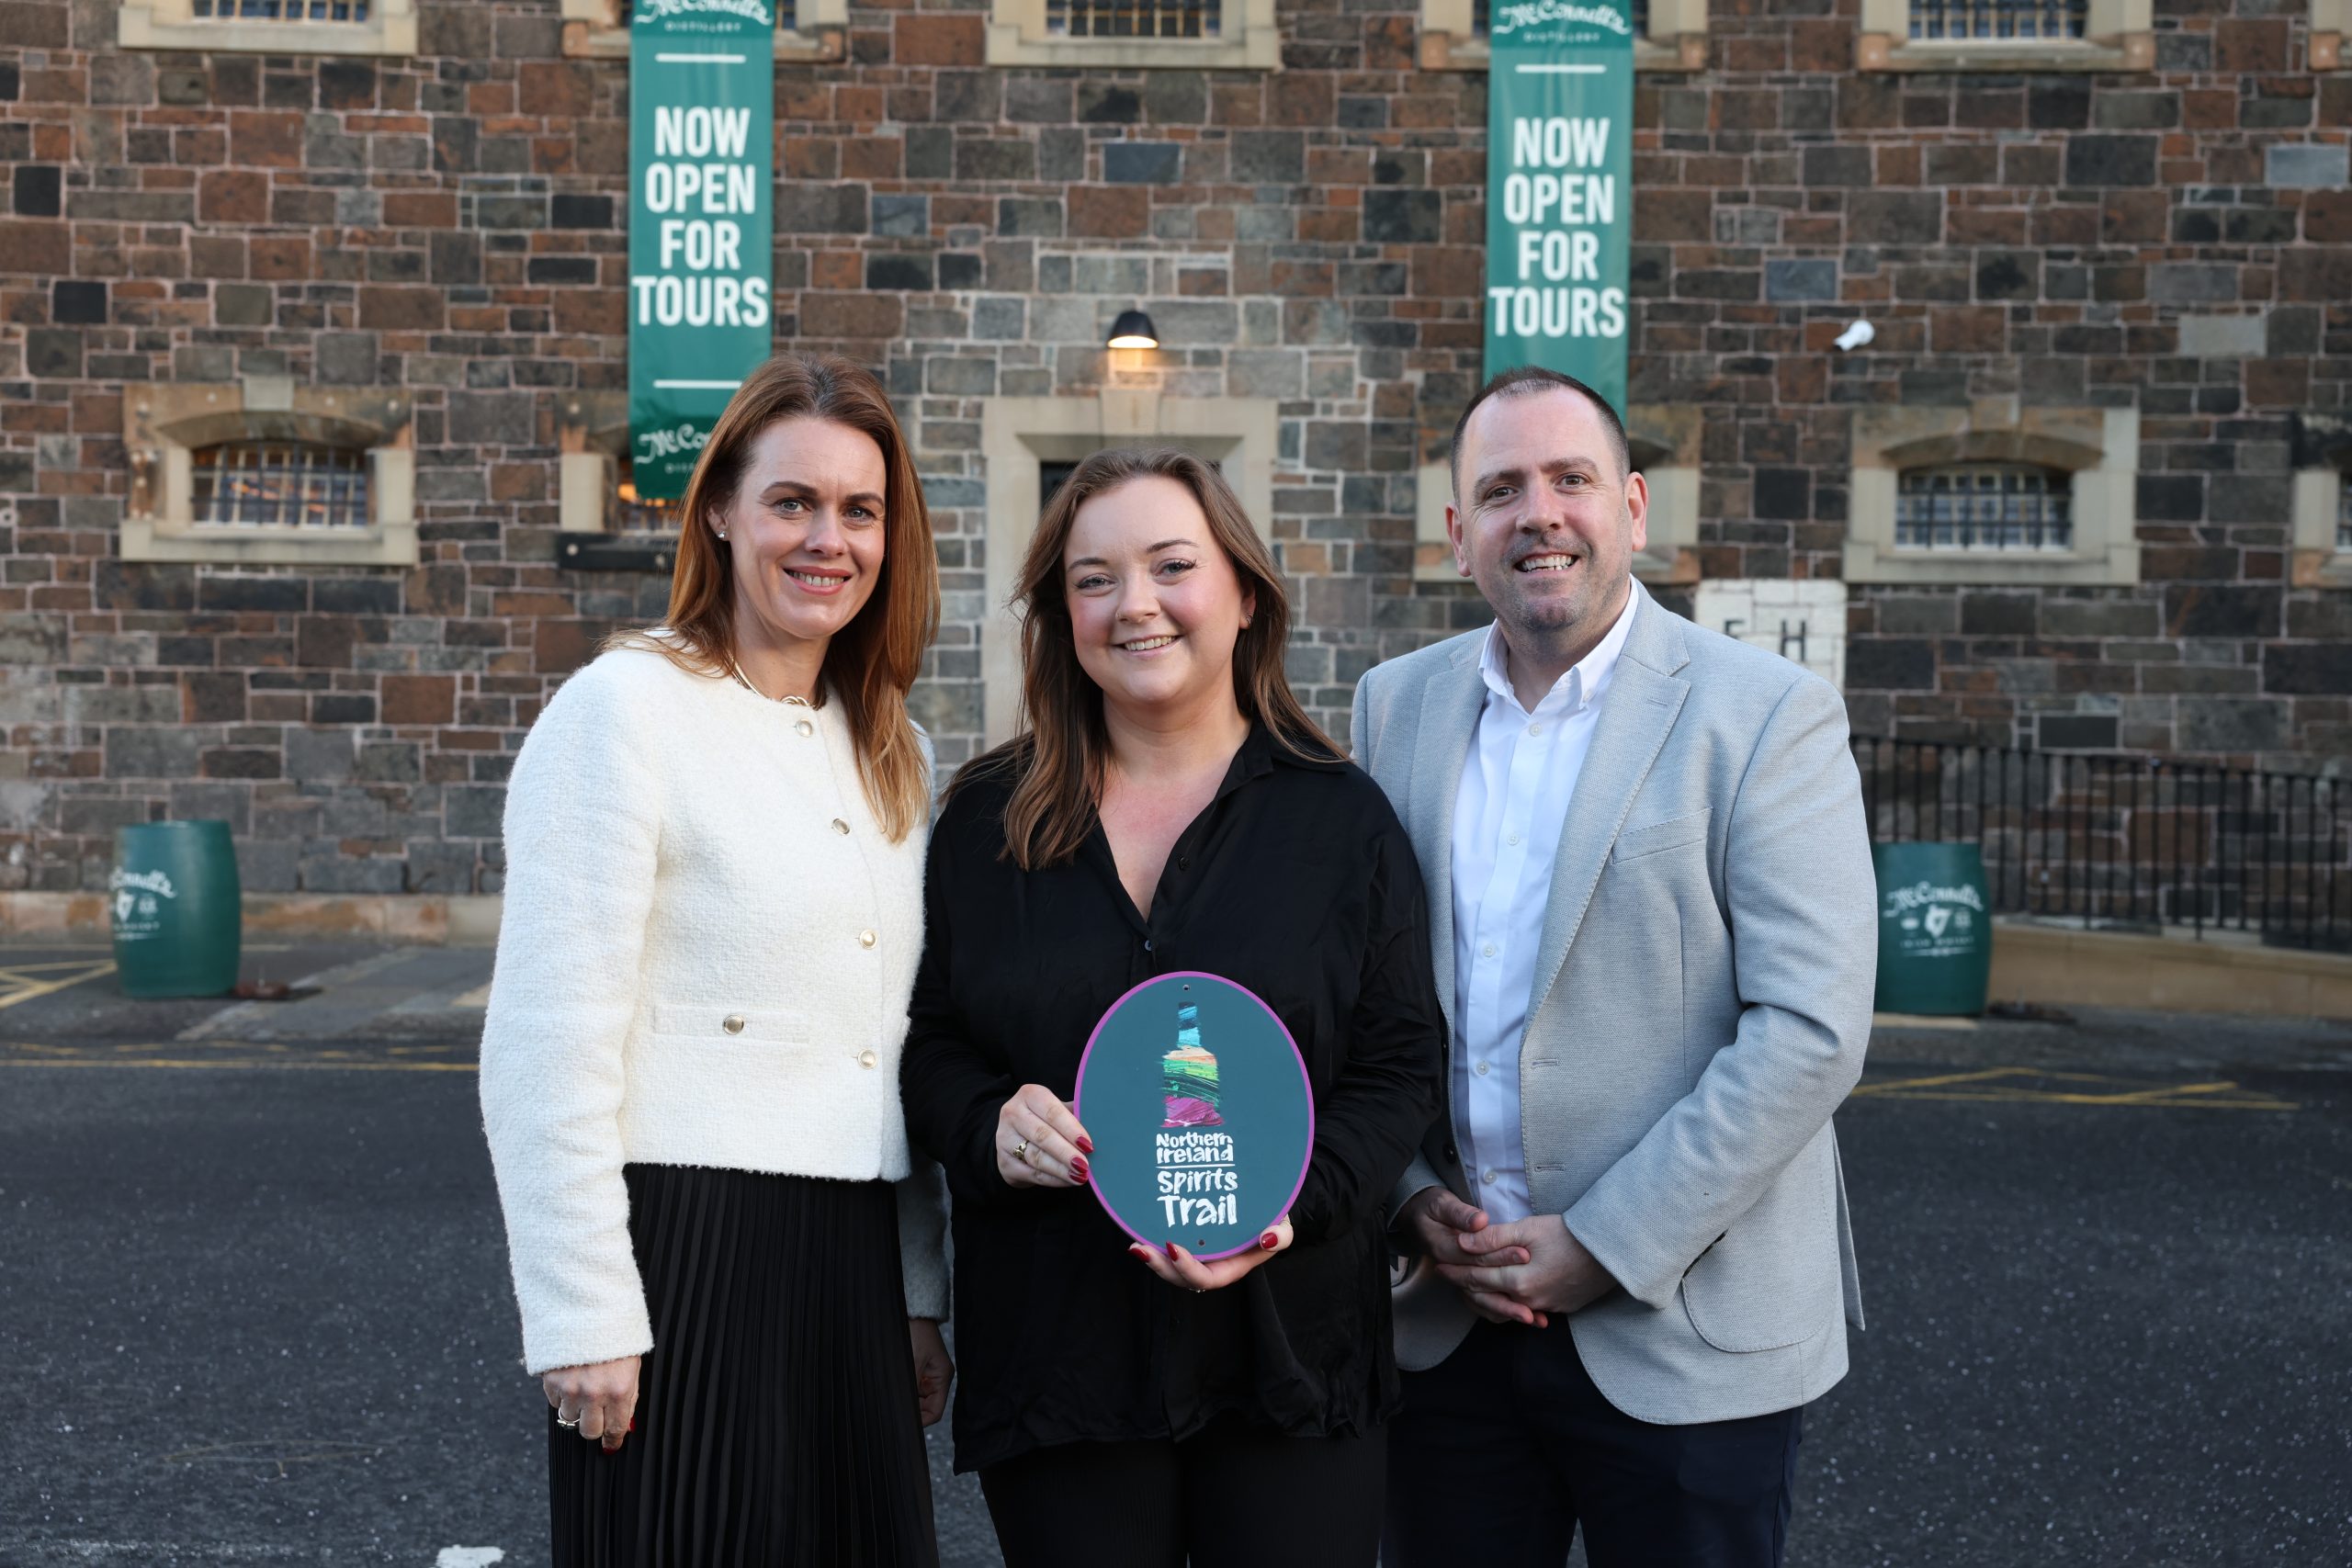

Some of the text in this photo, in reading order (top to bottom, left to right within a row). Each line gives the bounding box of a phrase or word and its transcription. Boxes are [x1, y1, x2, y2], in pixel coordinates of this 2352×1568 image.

[655, 106, 751, 157] NOW
[1514, 117, 1610, 168] NOW
[645, 162, 756, 214] OPEN
[1503, 173, 1614, 224] OPEN
[661, 220, 741, 270] FOR
[1518, 230, 1600, 281] FOR
[631, 276, 769, 327] TOURS
[1488, 286, 1626, 338] TOURS
[1156, 1132, 1233, 1147] Northern
[1156, 1145, 1234, 1164] Ireland
[1158, 1168, 1238, 1194] Spirits
[1157, 1193, 1238, 1228] Trail
